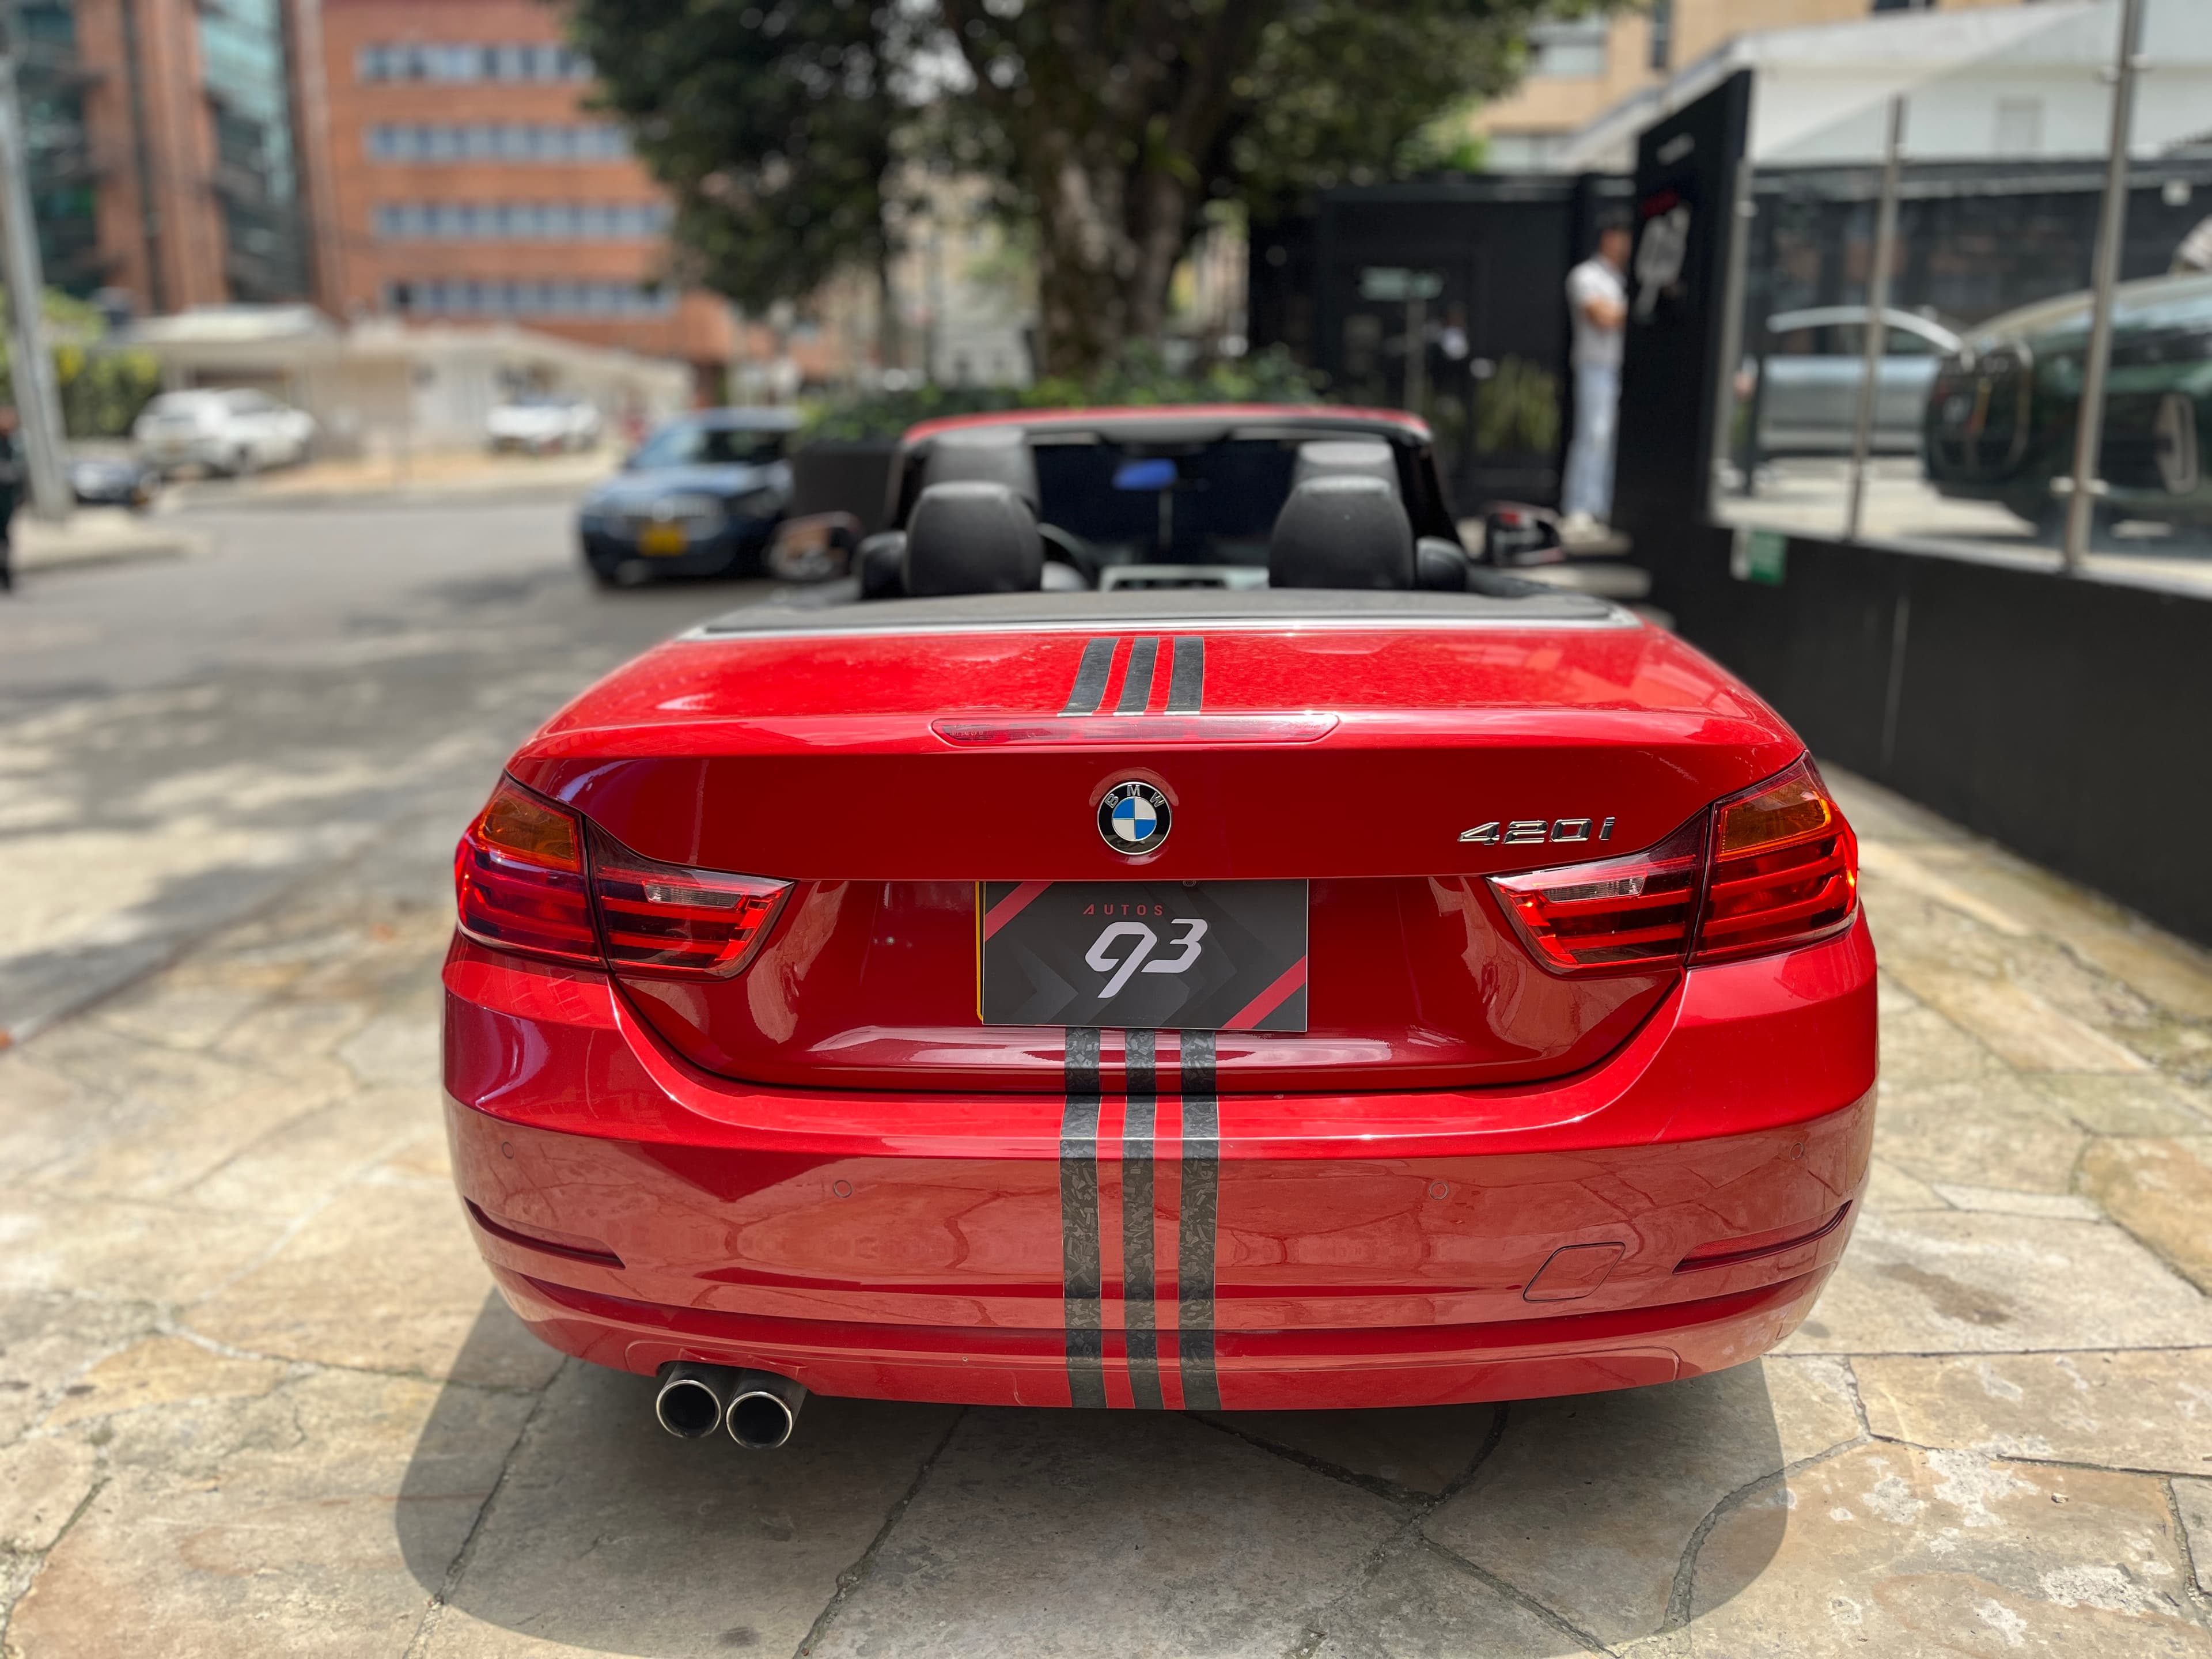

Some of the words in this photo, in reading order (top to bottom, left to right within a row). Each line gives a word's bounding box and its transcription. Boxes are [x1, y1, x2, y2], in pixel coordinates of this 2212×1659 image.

[1104, 785, 1165, 809] BMW
[1457, 816, 1616, 845] 420i
[1082, 904, 1164, 916] AUTOS
[1085, 918, 1209, 999] 93
